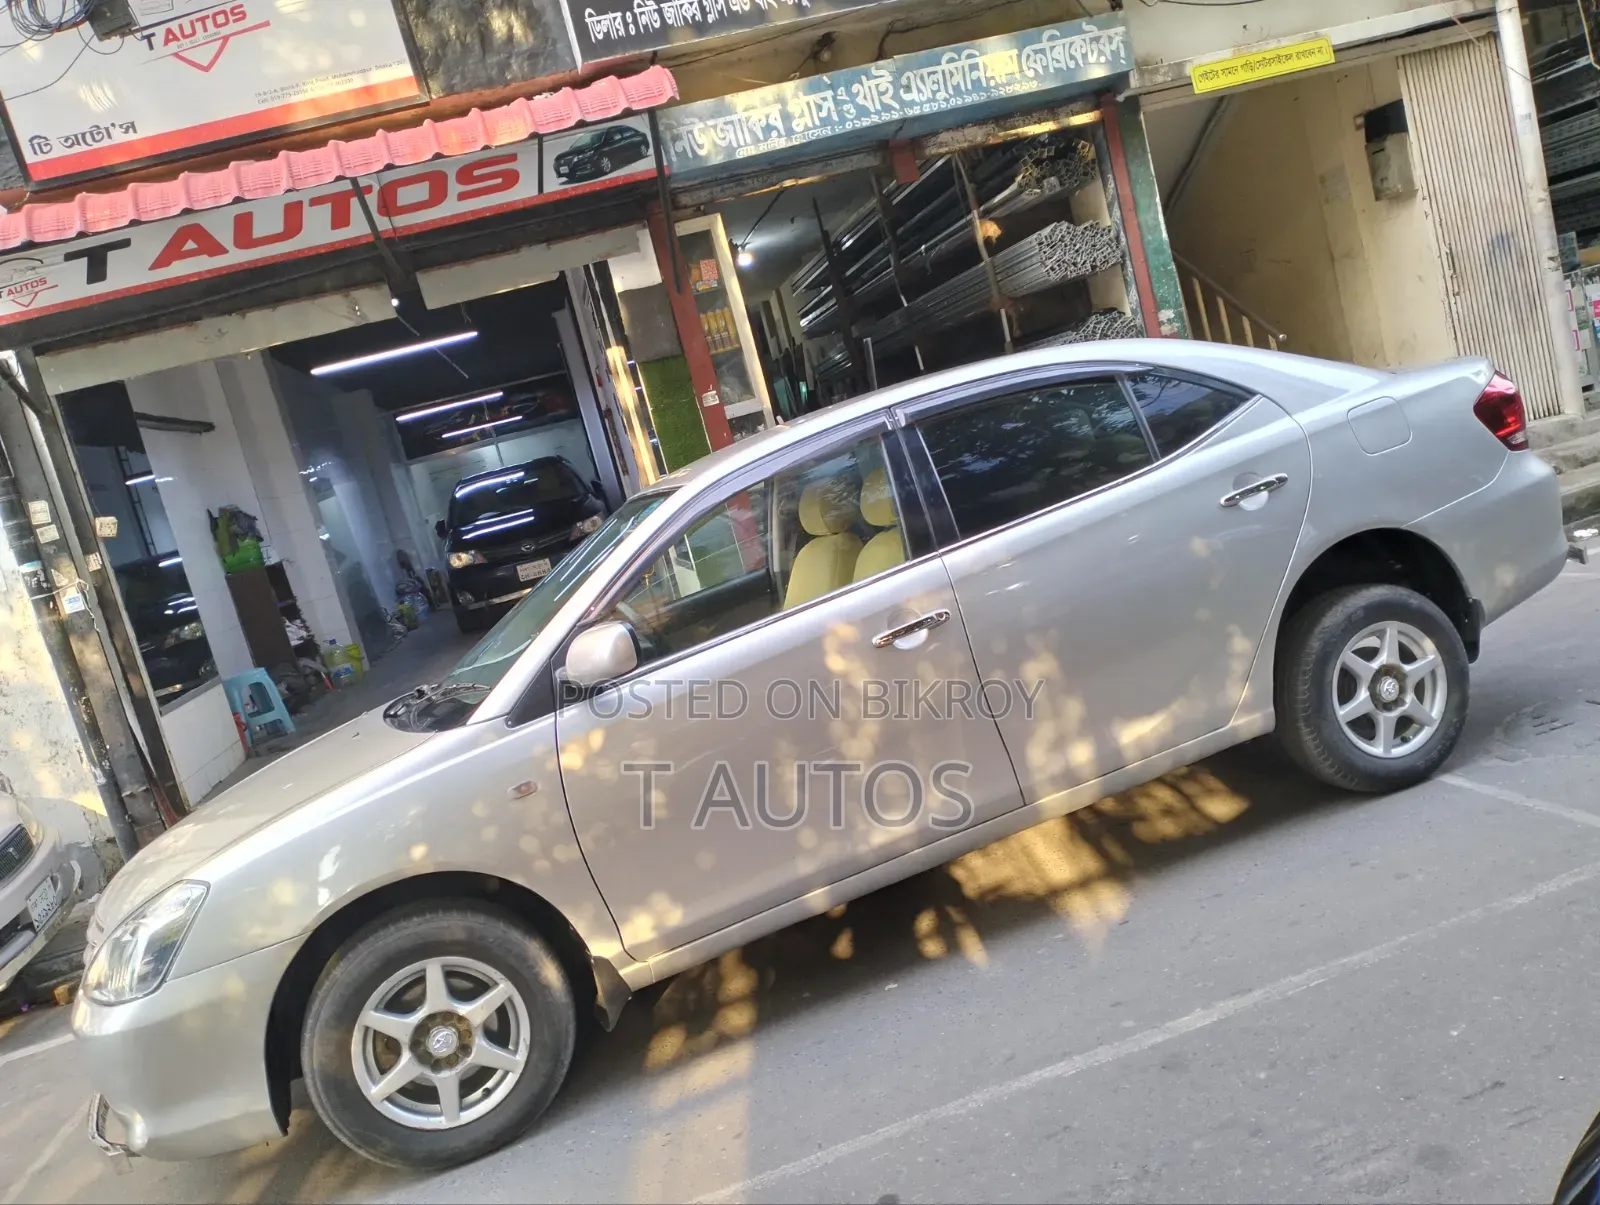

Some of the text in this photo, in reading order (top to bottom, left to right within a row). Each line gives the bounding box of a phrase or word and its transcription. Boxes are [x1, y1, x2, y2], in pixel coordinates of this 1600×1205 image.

[141, 3, 247, 51] T AUTOS
[585, 8, 626, 43] ডিলার
[633, 0, 661, 34] নিউ
[1220, 65, 1240, 79] সামনে
[705, 103, 786, 149] জাকির
[851, 66, 900, 114] থাই
[28, 134, 54, 156] টি
[63, 153, 521, 285] T AUTOS
[6, 276, 48, 297] AUTOS
